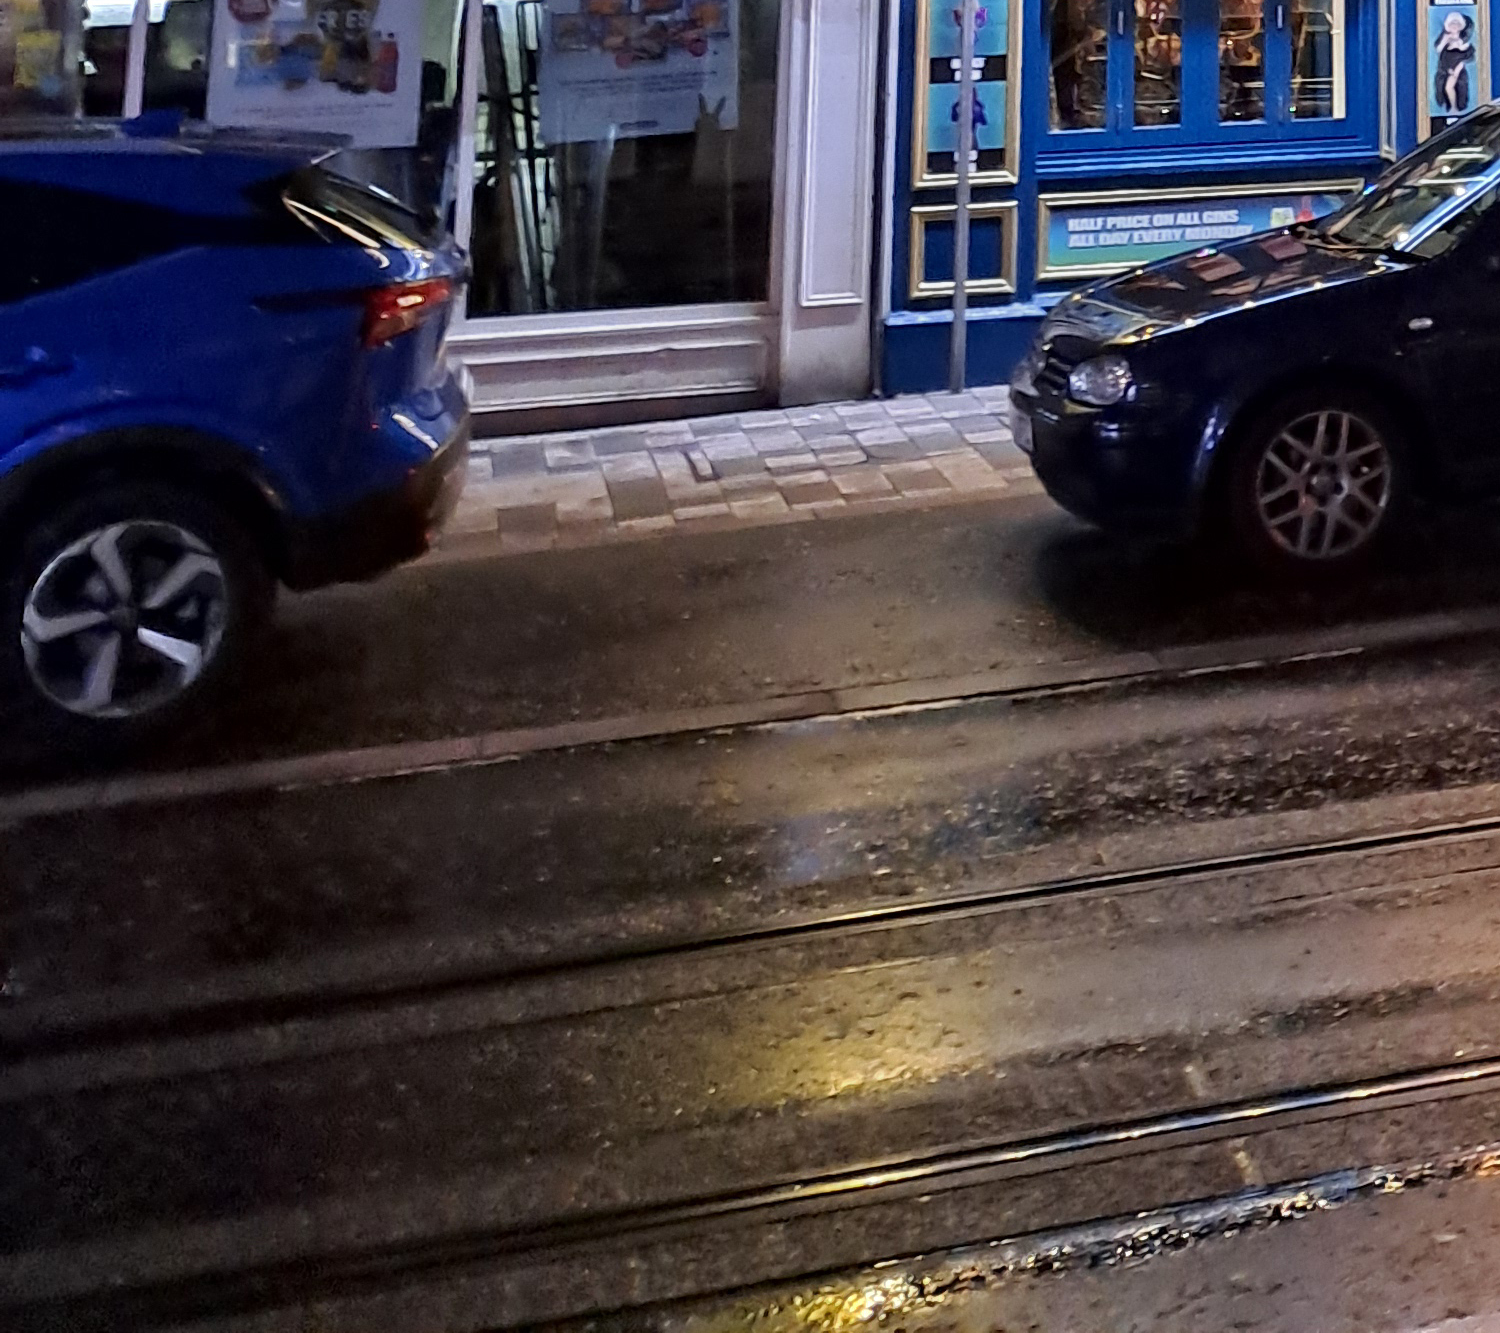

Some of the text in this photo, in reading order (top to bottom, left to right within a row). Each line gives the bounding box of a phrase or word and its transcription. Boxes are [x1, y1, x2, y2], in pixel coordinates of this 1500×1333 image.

[1067, 209, 1240, 232] HALF PRICE ON ALL GINS
[1068, 231, 1098, 248] ALL
[1099, 229, 1130, 247] DAY
[1132, 227, 1183, 245] EVERY
